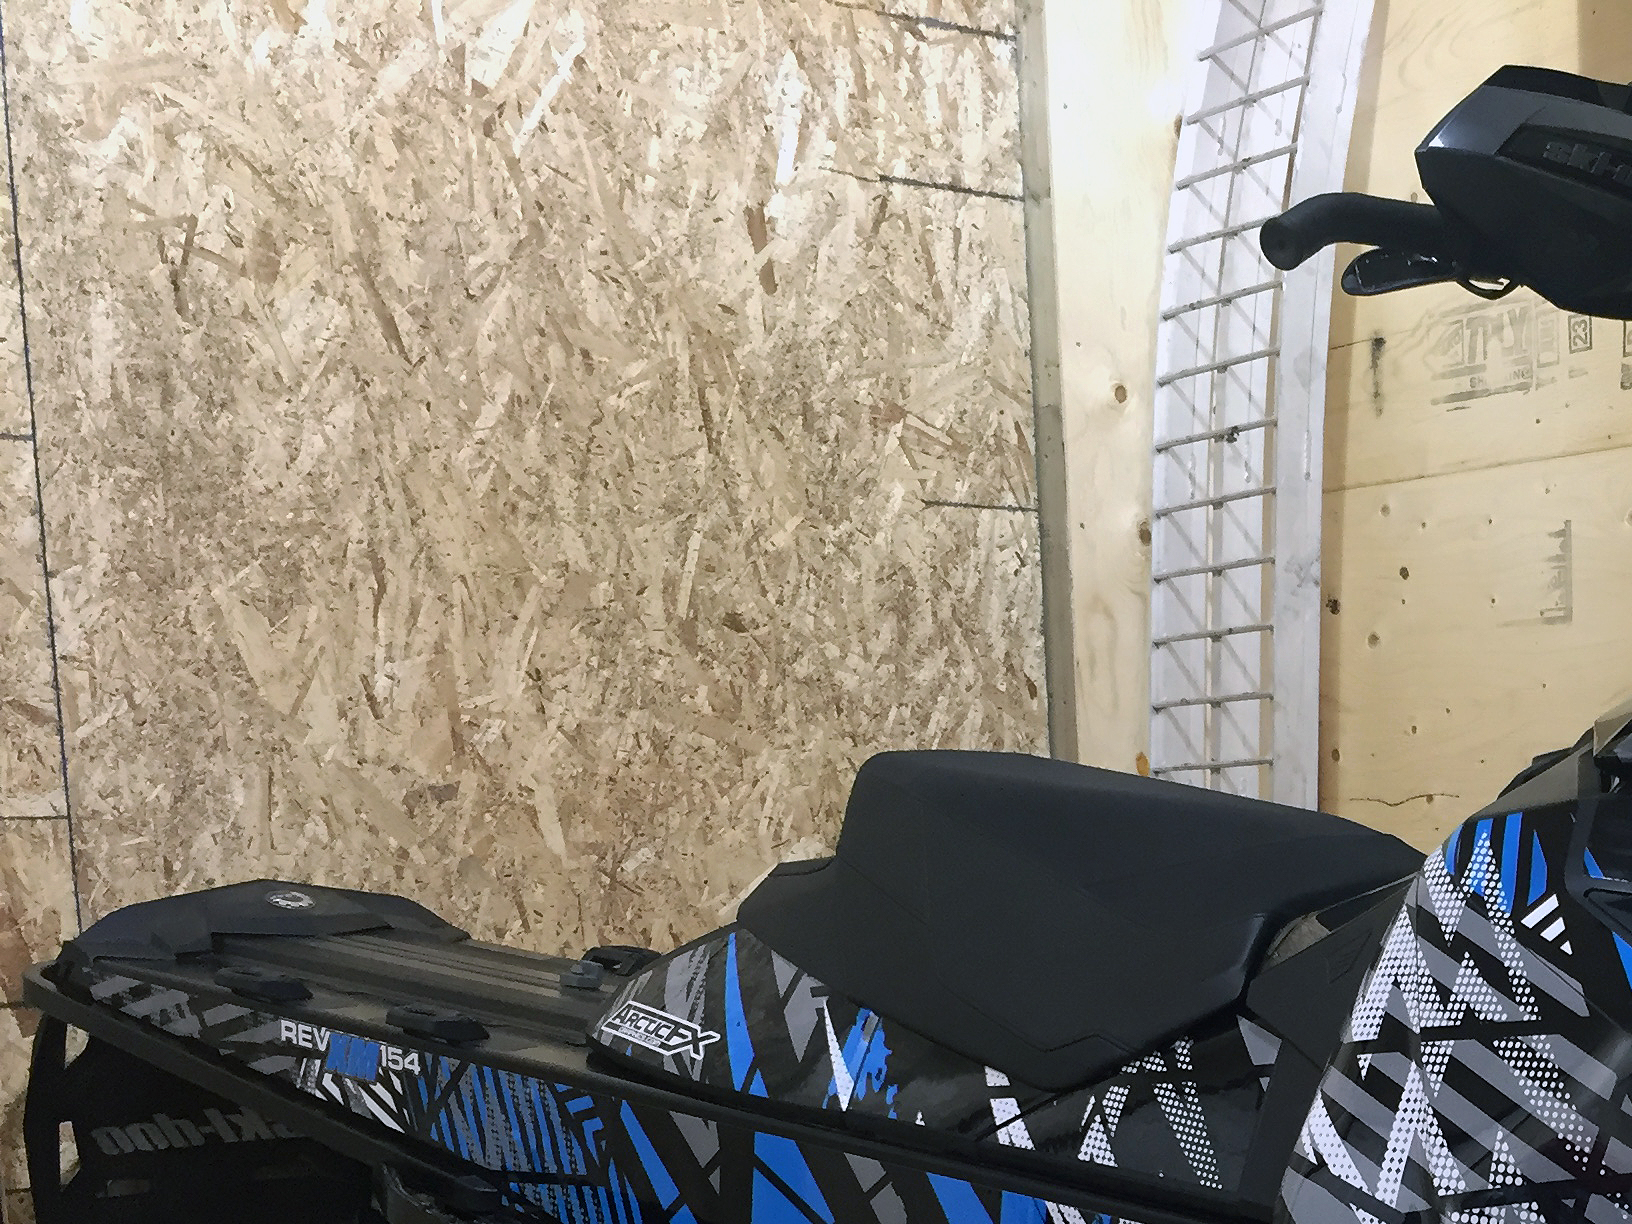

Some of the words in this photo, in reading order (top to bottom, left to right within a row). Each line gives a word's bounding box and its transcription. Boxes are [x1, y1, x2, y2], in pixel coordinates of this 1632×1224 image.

[1571, 318, 1589, 348] 23
[280, 1019, 331, 1052] REV
[379, 1045, 421, 1076] 154
